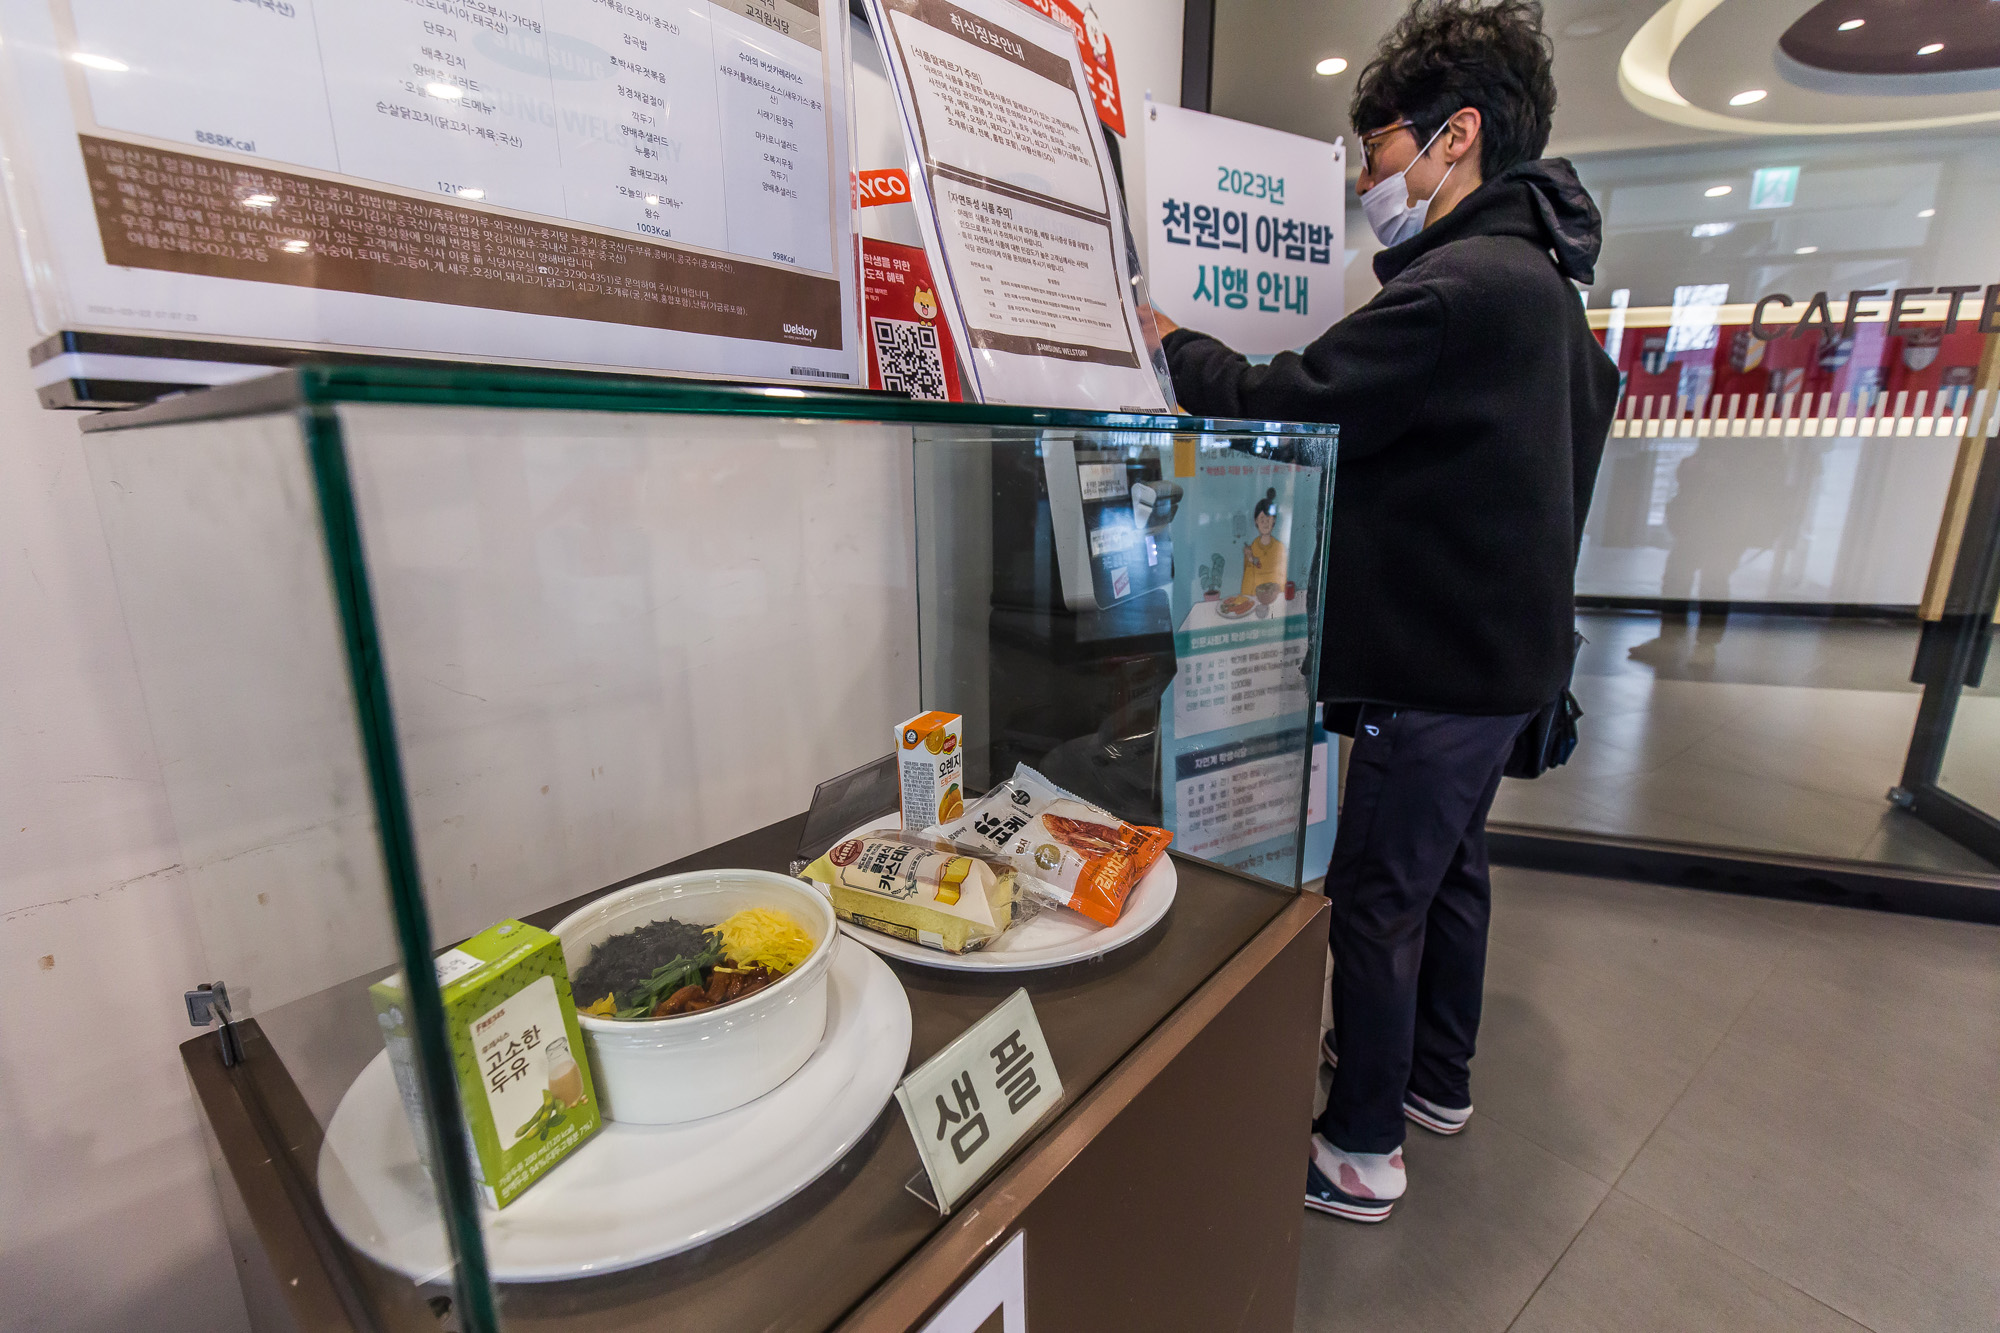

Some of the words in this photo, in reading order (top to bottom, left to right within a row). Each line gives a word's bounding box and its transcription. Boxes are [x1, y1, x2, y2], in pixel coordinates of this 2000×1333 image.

[423, 20, 457, 41] 단무지
[745, 3, 790, 35] 교직원식당
[623, 32, 648, 52] 잡곡밥
[949, 12, 1025, 61] 취식정보안내
[421, 45, 467, 70] 배추김치
[631, 109, 657, 128] 깍두기
[195, 130, 257, 152] 888Kcal
[620, 124, 670, 148] 양배추샐러드
[634, 145, 660, 162] 누룽지
[769, 169, 790, 184] 깍두기
[1217, 166, 1285, 206] 2023년
[946, 190, 980, 211] [자연독성
[980, 200, 995, 215] 식품
[994, 204, 1013, 220] 주의]
[636, 222, 672, 239] 1003Kcal
[1162, 198, 1249, 254] 천원의
[1255, 214, 1334, 265] 아침밥
[424, 232, 446, 247] 의해
[484, 242, 494, 255] 수
[333, 231, 360, 247] 있는
[423, 245, 445, 260] 식사
[448, 249, 470, 263] 이용
[624, 277, 656, 292] 문의하여
[658, 283, 679, 295] 주시기
[772, 251, 796, 264] 998Kcal
[892, 258, 911, 272] 위한
[1192, 264, 1249, 310] 시행
[1256, 271, 1309, 316] 안내
[1036, 342, 1062, 355] SAMSUNG
[938, 753, 961, 779] 오렌지
[837, 840, 858, 864] KIRIN
[870, 845, 895, 874] 클래식
[485, 1024, 541, 1076] 고소한
[491, 1057, 530, 1094] 두유
[935, 1029, 1042, 1165] 샘플
